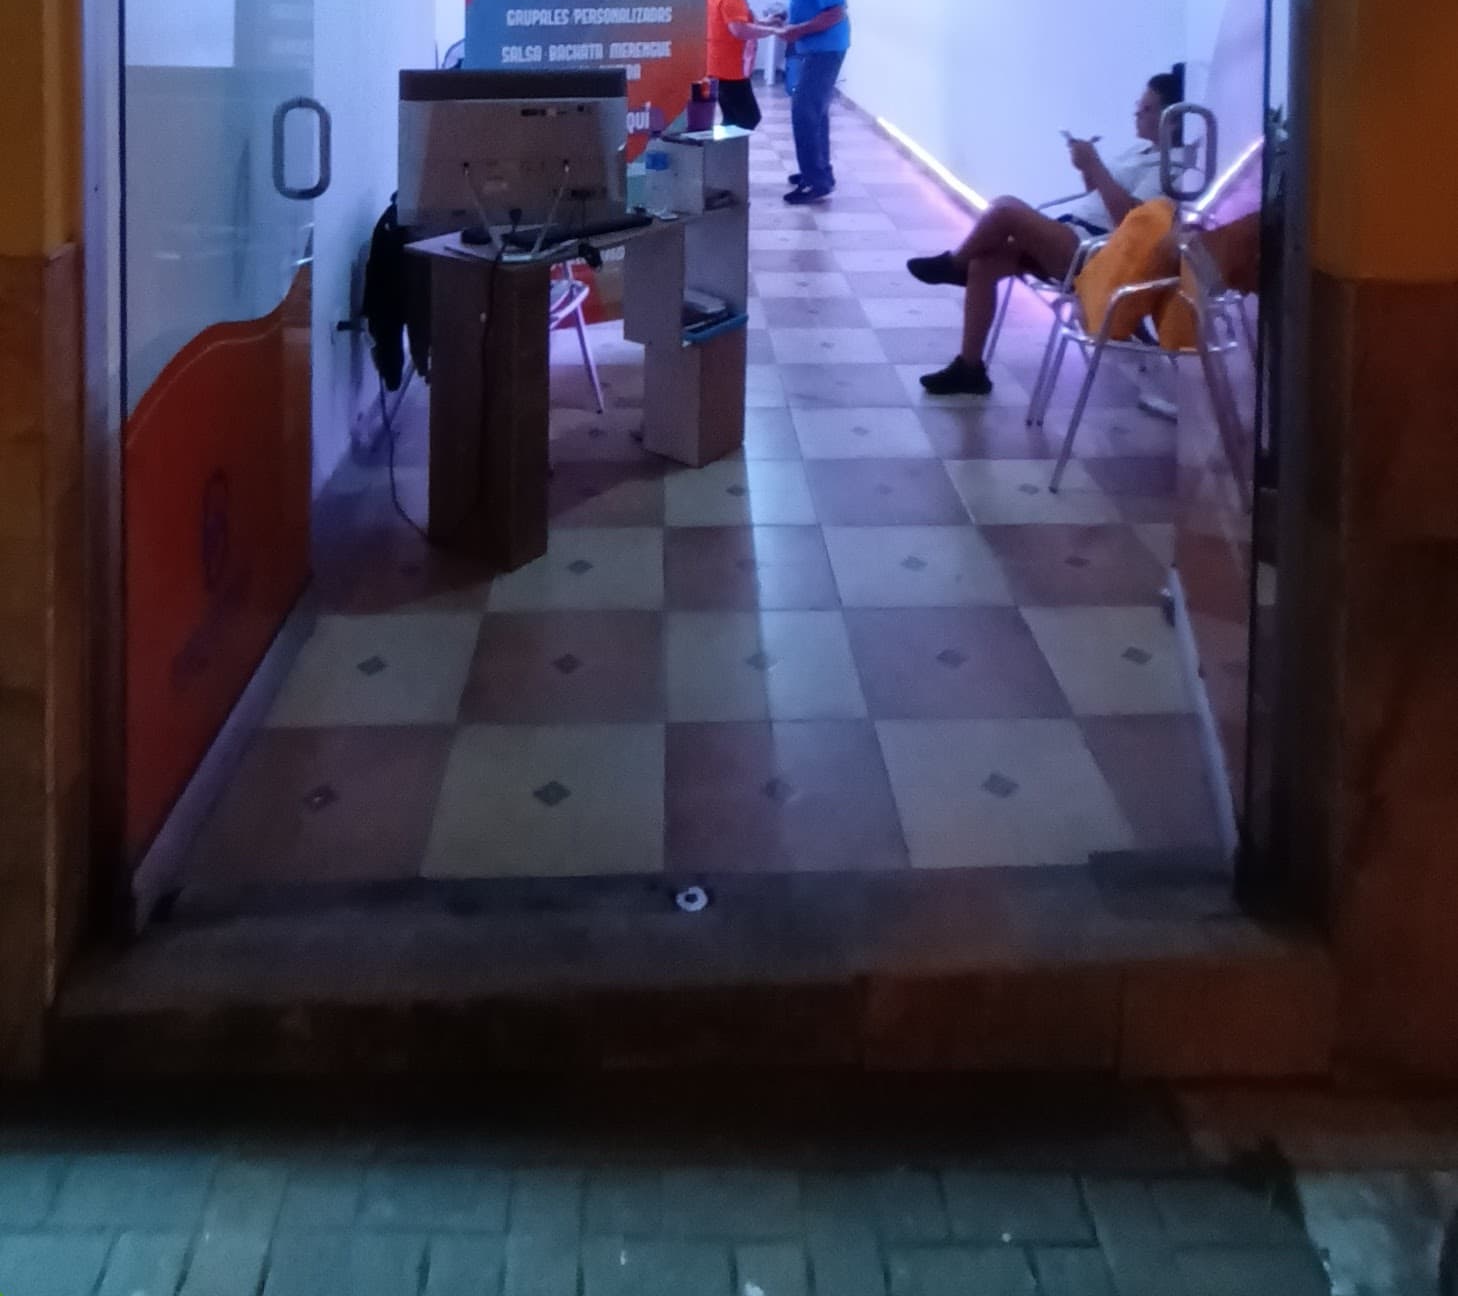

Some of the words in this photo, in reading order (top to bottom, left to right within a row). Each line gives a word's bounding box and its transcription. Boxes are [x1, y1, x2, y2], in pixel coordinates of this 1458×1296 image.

[506, 9, 569, 26] GRUPALES
[573, 6, 672, 24] PERSONALIZADAS
[502, 45, 542, 63] SALSA
[549, 43, 603, 61] BACHATA
[609, 41, 672, 58] MERENGUE
